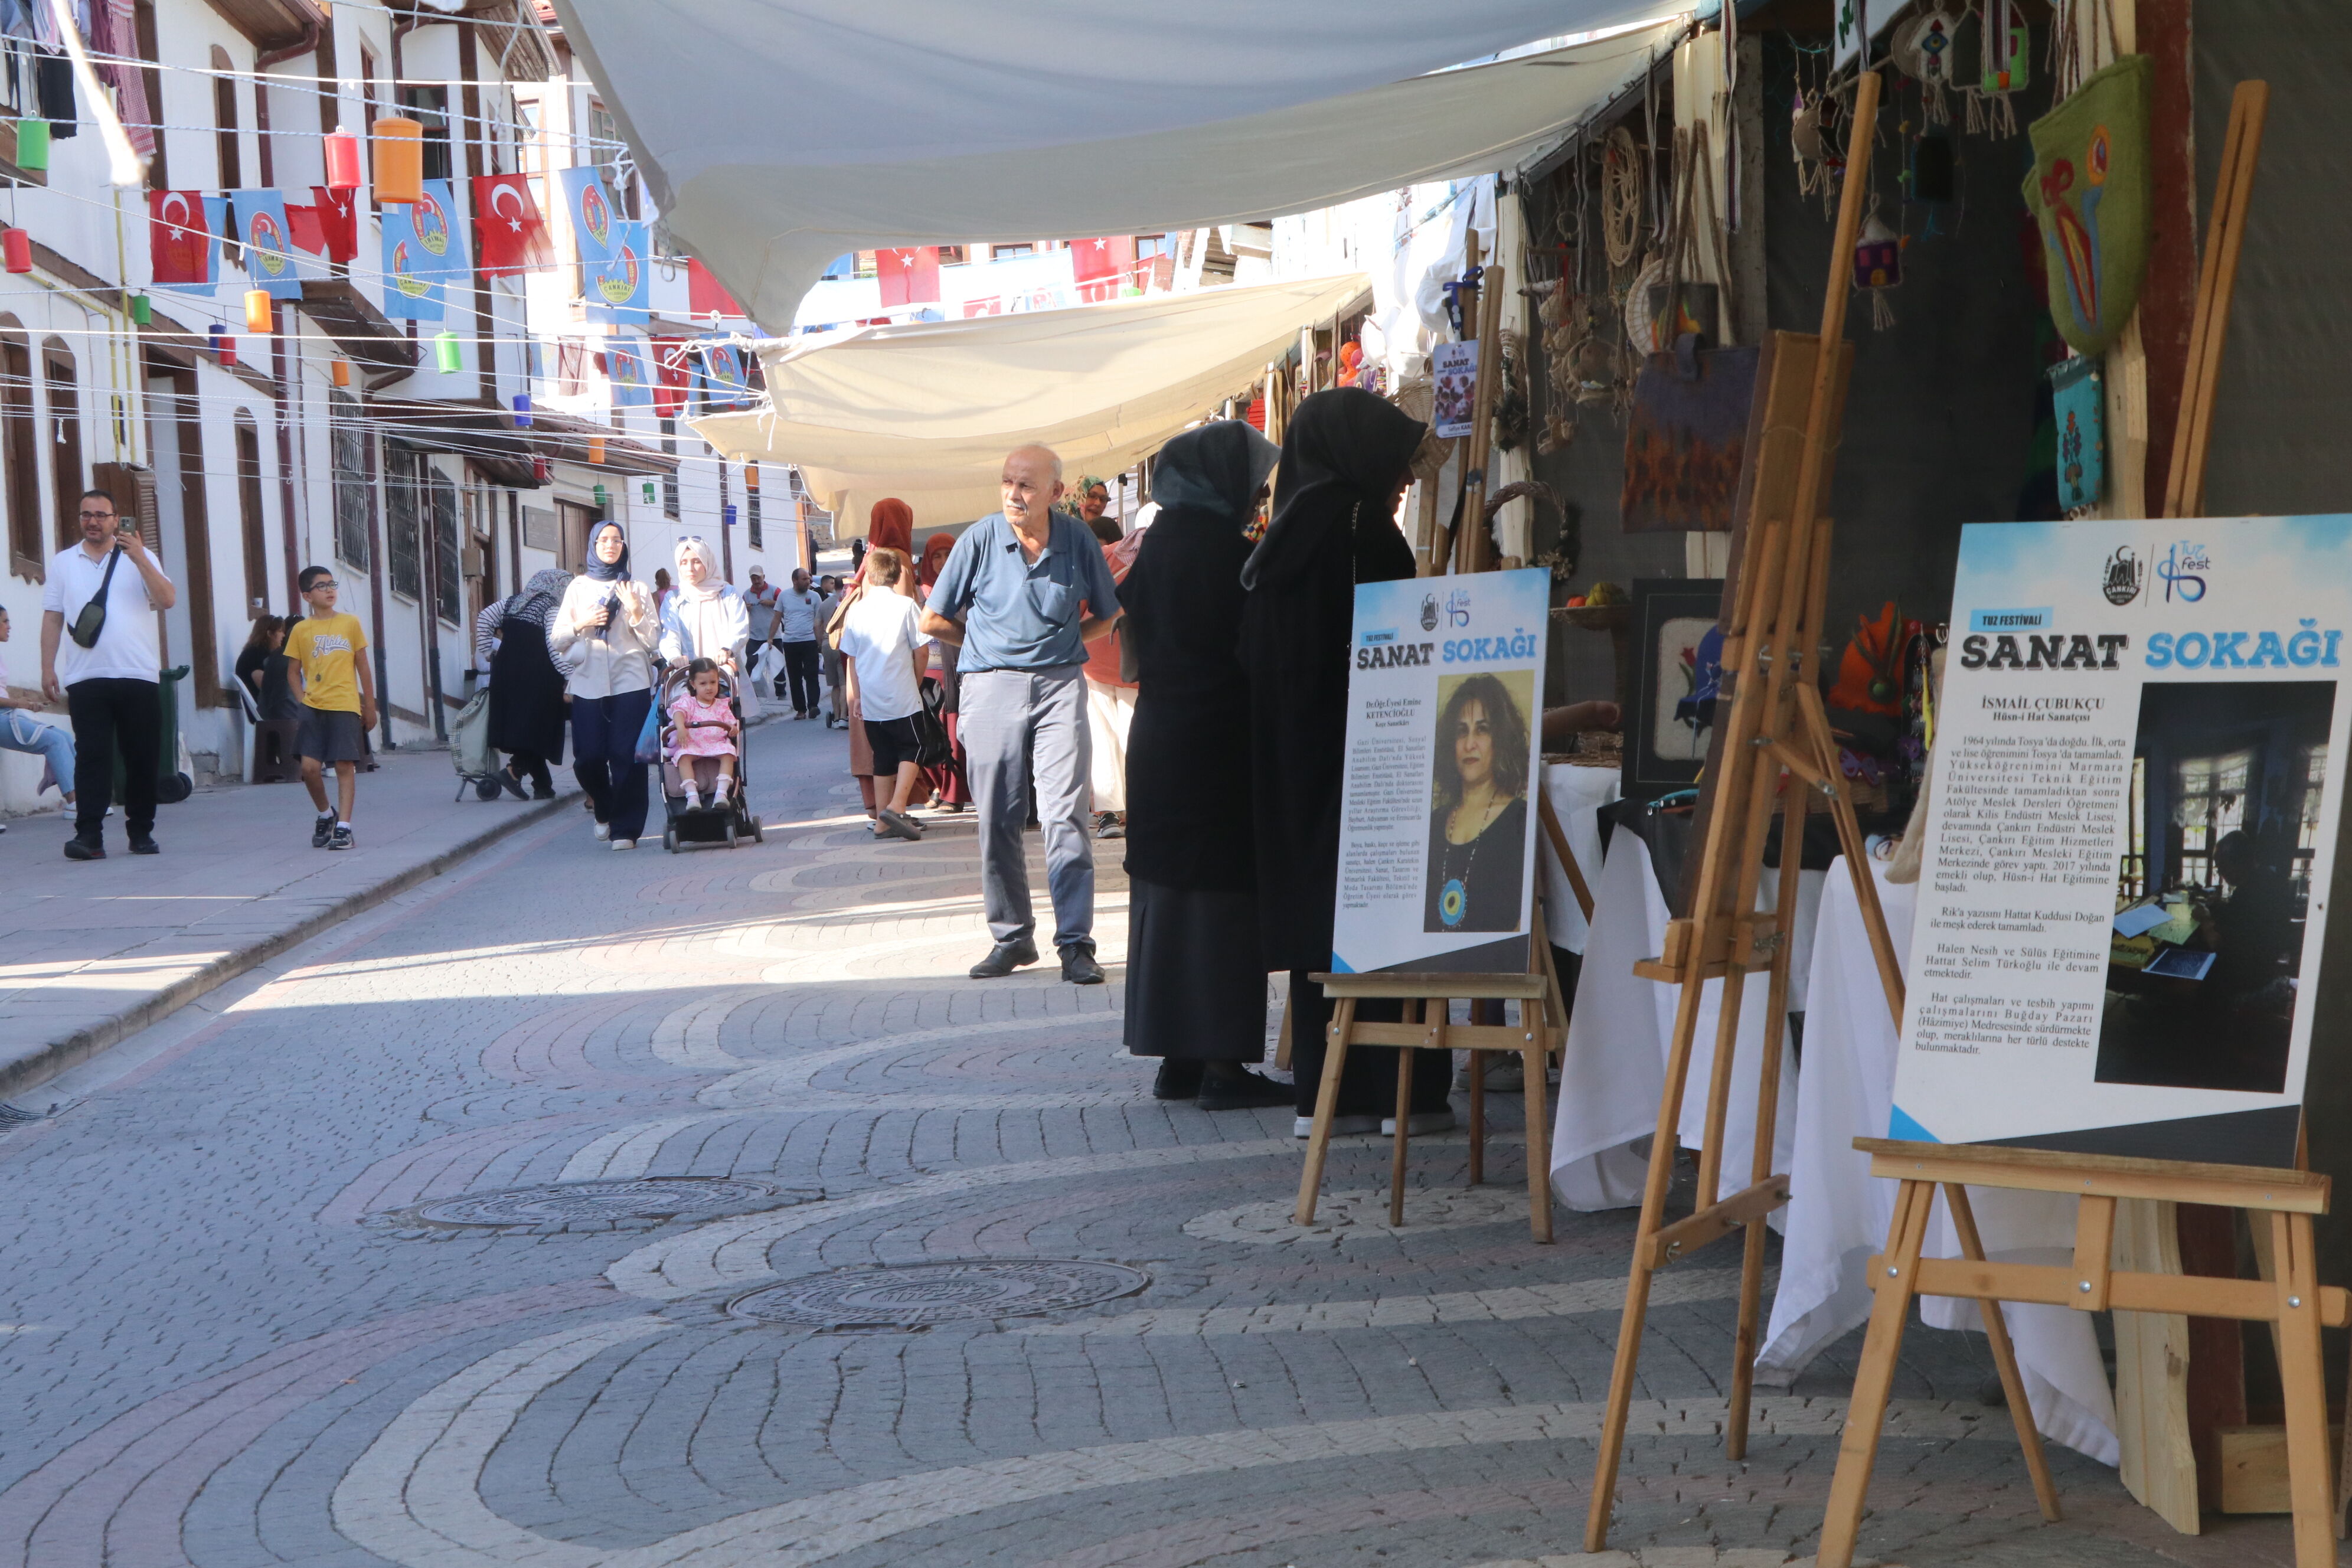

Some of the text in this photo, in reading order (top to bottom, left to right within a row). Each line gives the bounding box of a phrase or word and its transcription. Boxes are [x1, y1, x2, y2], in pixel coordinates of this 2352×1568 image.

[1443, 358, 1469, 368] SANAT
[2182, 557, 2211, 570] fest
[1982, 613, 2042, 626] TUZ FESTİVALİ
[1357, 627, 1537, 671] SANAT SOKAĞI
[1961, 618, 2343, 671] SANAT SOKAĞI
[1403, 698, 1422, 706] Emine
[1982, 695, 2105, 713] İSMAİL ÇUBUKÇU
[1993, 711, 2090, 723] Hüsn-i Hat Sanatçısı
[1963, 736, 1984, 745] 1964
[1985, 736, 2015, 747] yılında
[2059, 736, 2089, 749] doğdu.
[2091, 736, 2106, 747] İlk,
[2108, 739, 2125, 747] orta
[1964, 747, 1978, 757] lise
[1980, 749, 2028, 760] öğrenimini
[2074, 749, 2123, 759] tamamladı.
[1950, 759, 2122, 772] Yükseköğrenimini Marmara
[1948, 771, 2121, 786] Üniversitesi Teknik Eğitim
[1946, 784, 2008, 795] Fakültesinde
[2014, 786, 2086, 796] tamamladıktan
[1945, 796, 2118, 811] Atölye Meslek Dersleri Öğretmeni
[1943, 808, 2116, 822] olarak Kilis Endüstri Meslek Lisesi,
[1941, 820, 2115, 834] devamında Çankırı Endüstri Meslek
[1941, 832, 2113, 847] Lisesi, Çankırı Eğitim Hizmetleri
[1939, 845, 2112, 861] Merkezi, Çankırı Mesleki Eğitim
[1938, 857, 2111, 873] Merkezinde görev yaptı. 2017 yılında
[1936, 870, 2109, 886] emekli olup, Hüsn-i Hat Eğitimine
[1934, 881, 1968, 894] başladı.
[1966, 910, 2001, 919] yazısını
[2004, 909, 2031, 919] Hattat
[2034, 910, 2071, 920] Kuddusi
[2075, 912, 2104, 924] Doğan
[1930, 918, 2046, 932] ile meşk ederek tamamladı.
[1937, 943, 1965, 953] Halen
[1971, 945, 1998, 955] Nesih
[2020, 947, 2047, 958] Sülüs
[2053, 948, 2100, 961] Eğitimine
[1926, 955, 2098, 972] Hattat Selim Türkoğlu ile devam
[1923, 968, 1972, 979] etmektedir.
[1931, 992, 1948, 1002] Hat
[1953, 994, 2004, 1006] çalışmaları
[2027, 998, 2055, 1008] tesbih
[2060, 1001, 2093, 1012] yapımı
[1919, 1004, 2092, 1023] çalışmalarını Buğday Pazarı
[1971, 1019, 2032, 1032] Medresesinde
[2035, 1024, 2091, 1035] sürdürmekte
[1916, 1028, 2089, 1048] olup, meraklılarına her türlü destekte
[1915, 1040, 1980, 1054] bulunmaktadır.
